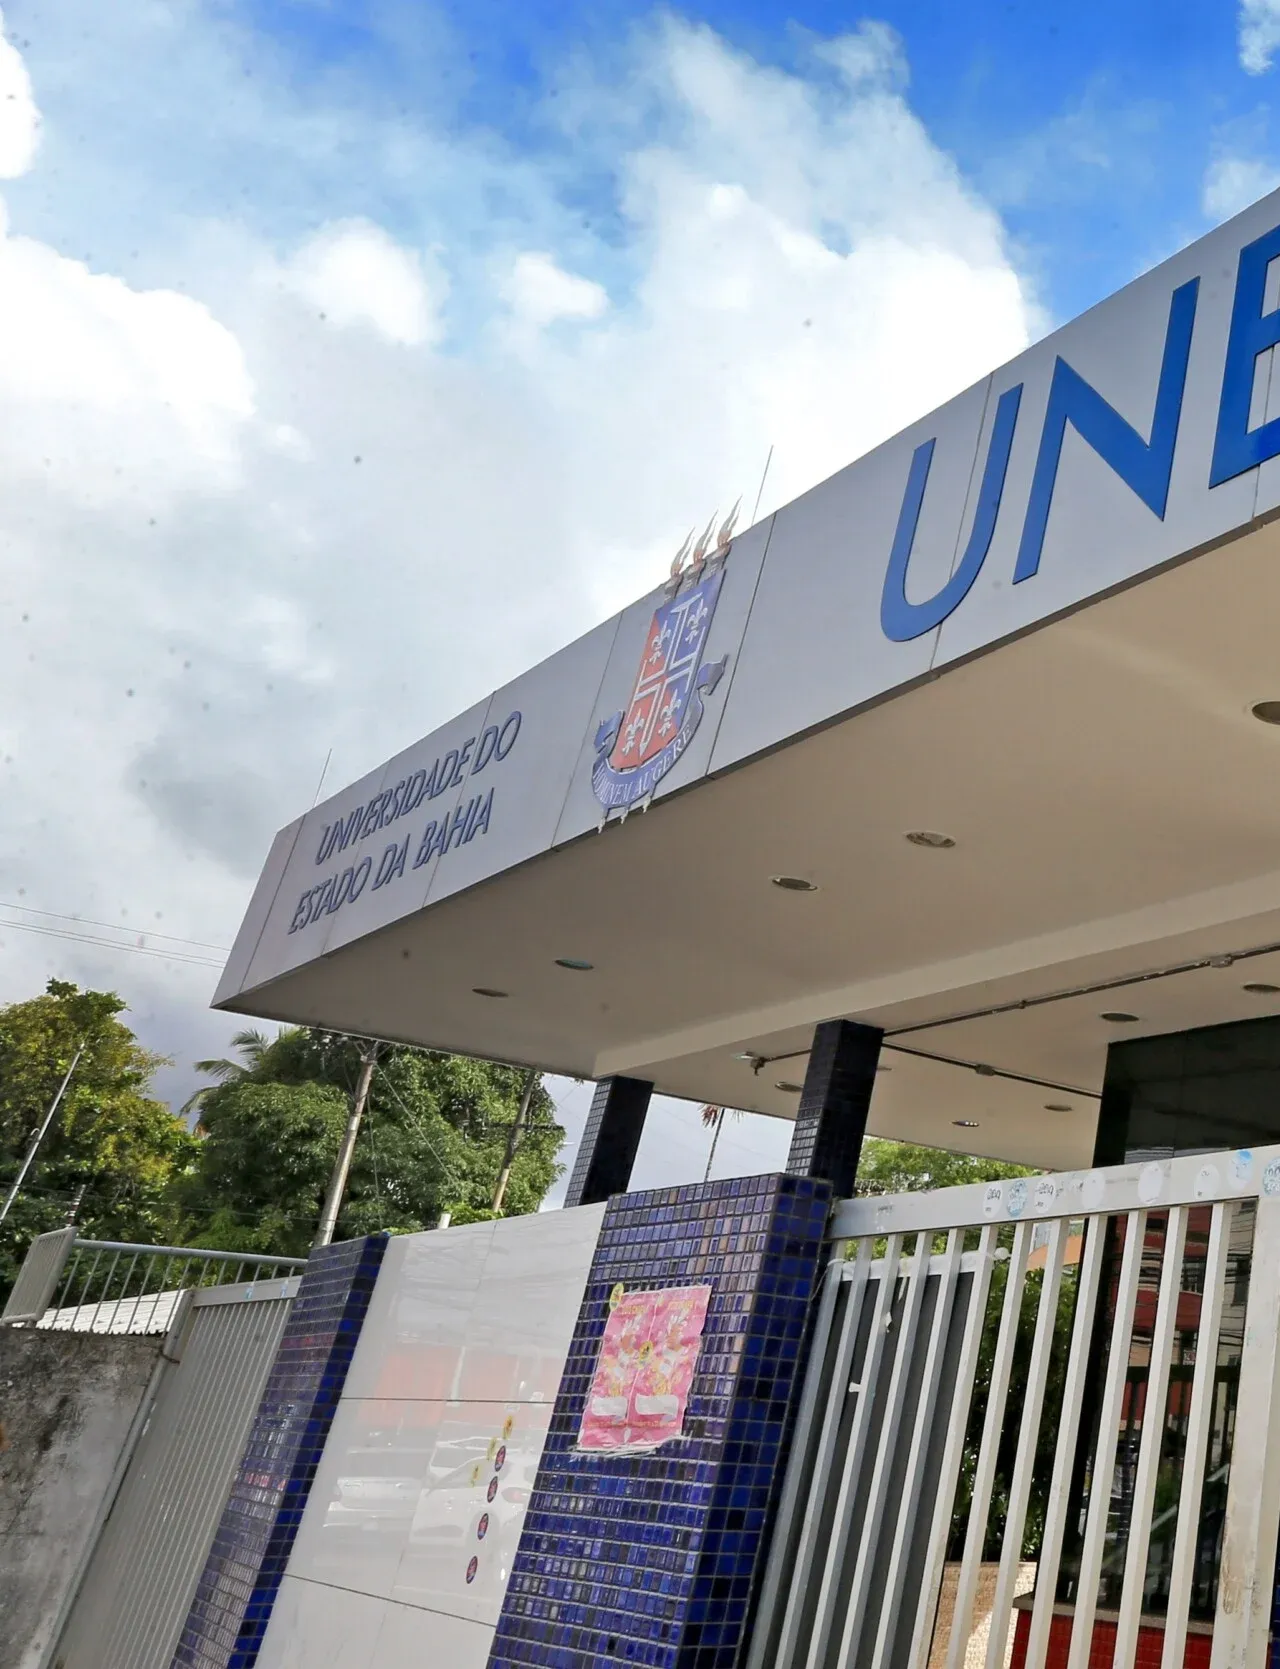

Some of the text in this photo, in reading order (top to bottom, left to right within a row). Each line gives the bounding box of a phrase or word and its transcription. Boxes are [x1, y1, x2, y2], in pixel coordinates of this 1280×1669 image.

[287, 787, 495, 936] ESTADO DA BAHIA
[315, 711, 522, 865] UNIVERSIDADE DO
